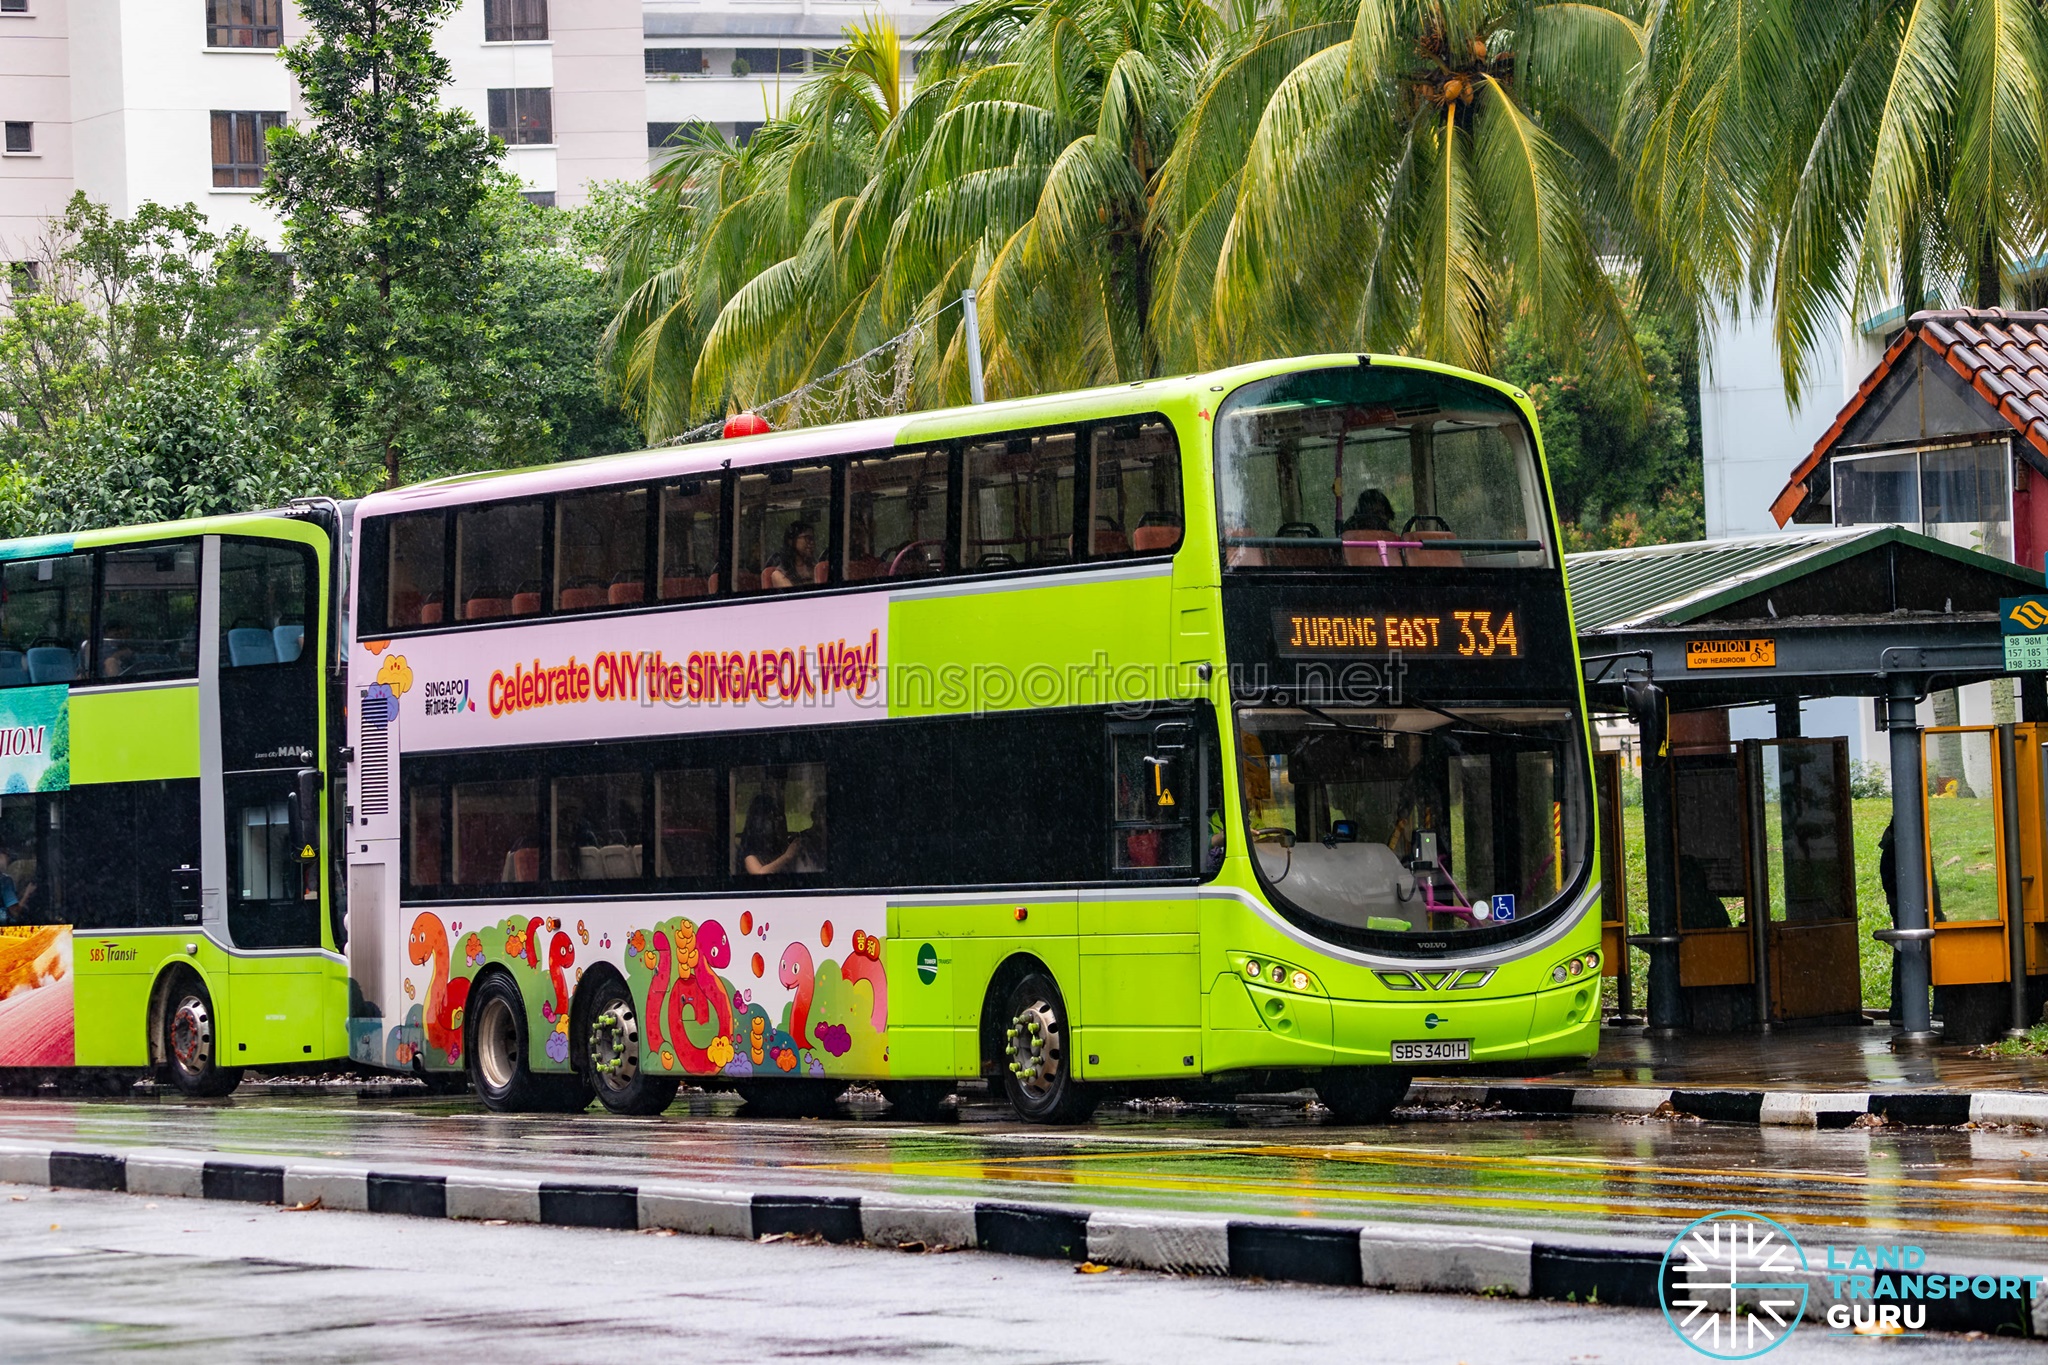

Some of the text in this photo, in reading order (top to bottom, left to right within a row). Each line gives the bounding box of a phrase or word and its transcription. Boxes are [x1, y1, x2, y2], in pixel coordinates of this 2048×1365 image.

[1290, 611, 1518, 656] JURONG EAST 334
[1692, 641, 1746, 653] CAUTION
[2010, 637, 2020, 646] 98
[2025, 637, 2041, 645] 98M
[2008, 649, 2022, 657] 157
[2027, 648, 2041, 656] 185
[2008, 660, 2023, 669] 198
[2027, 659, 2041, 668] 333
[489, 660, 590, 718] Celebrate
[594, 650, 642, 704] CNY
[644, 650, 684, 702] the
[816, 629, 879, 700] Way!
[90, 944, 138, 963] SBS Transit
[1395, 1043, 1466, 1059] SBS 3401H
